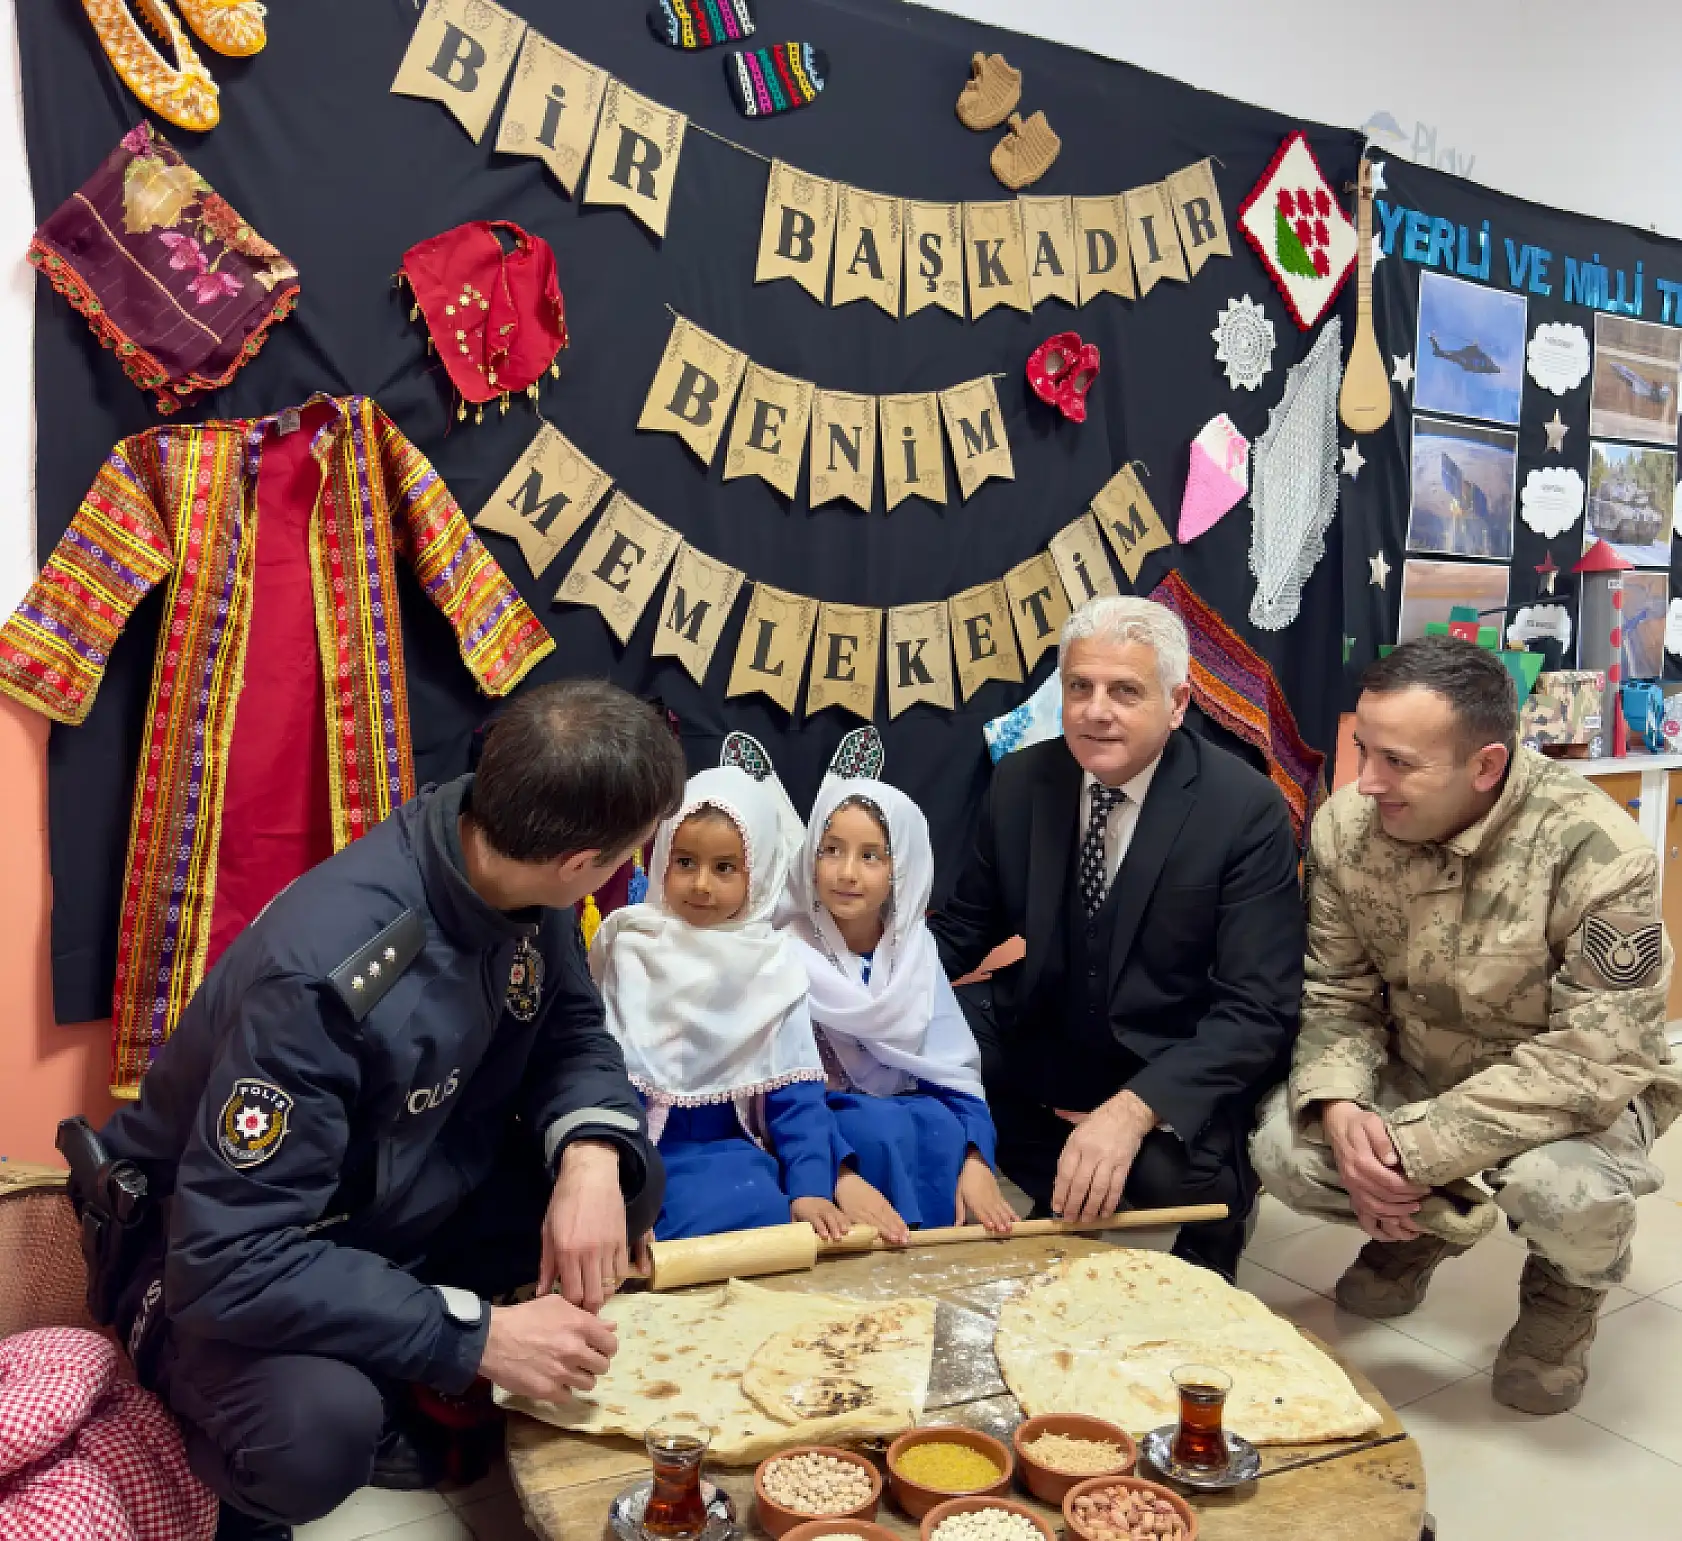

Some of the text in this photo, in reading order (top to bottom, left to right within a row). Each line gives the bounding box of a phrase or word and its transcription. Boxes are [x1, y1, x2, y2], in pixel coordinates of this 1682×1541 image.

[426, 20, 1218, 293] BİR BAŞKADIR
[1376, 199, 1491, 281] YERLİ
[1504, 237, 1554, 297] VE
[1564, 253, 1644, 316] MİLLİ
[664, 359, 1000, 484] BENİM
[506, 466, 1151, 688] MEMLEKETİM
